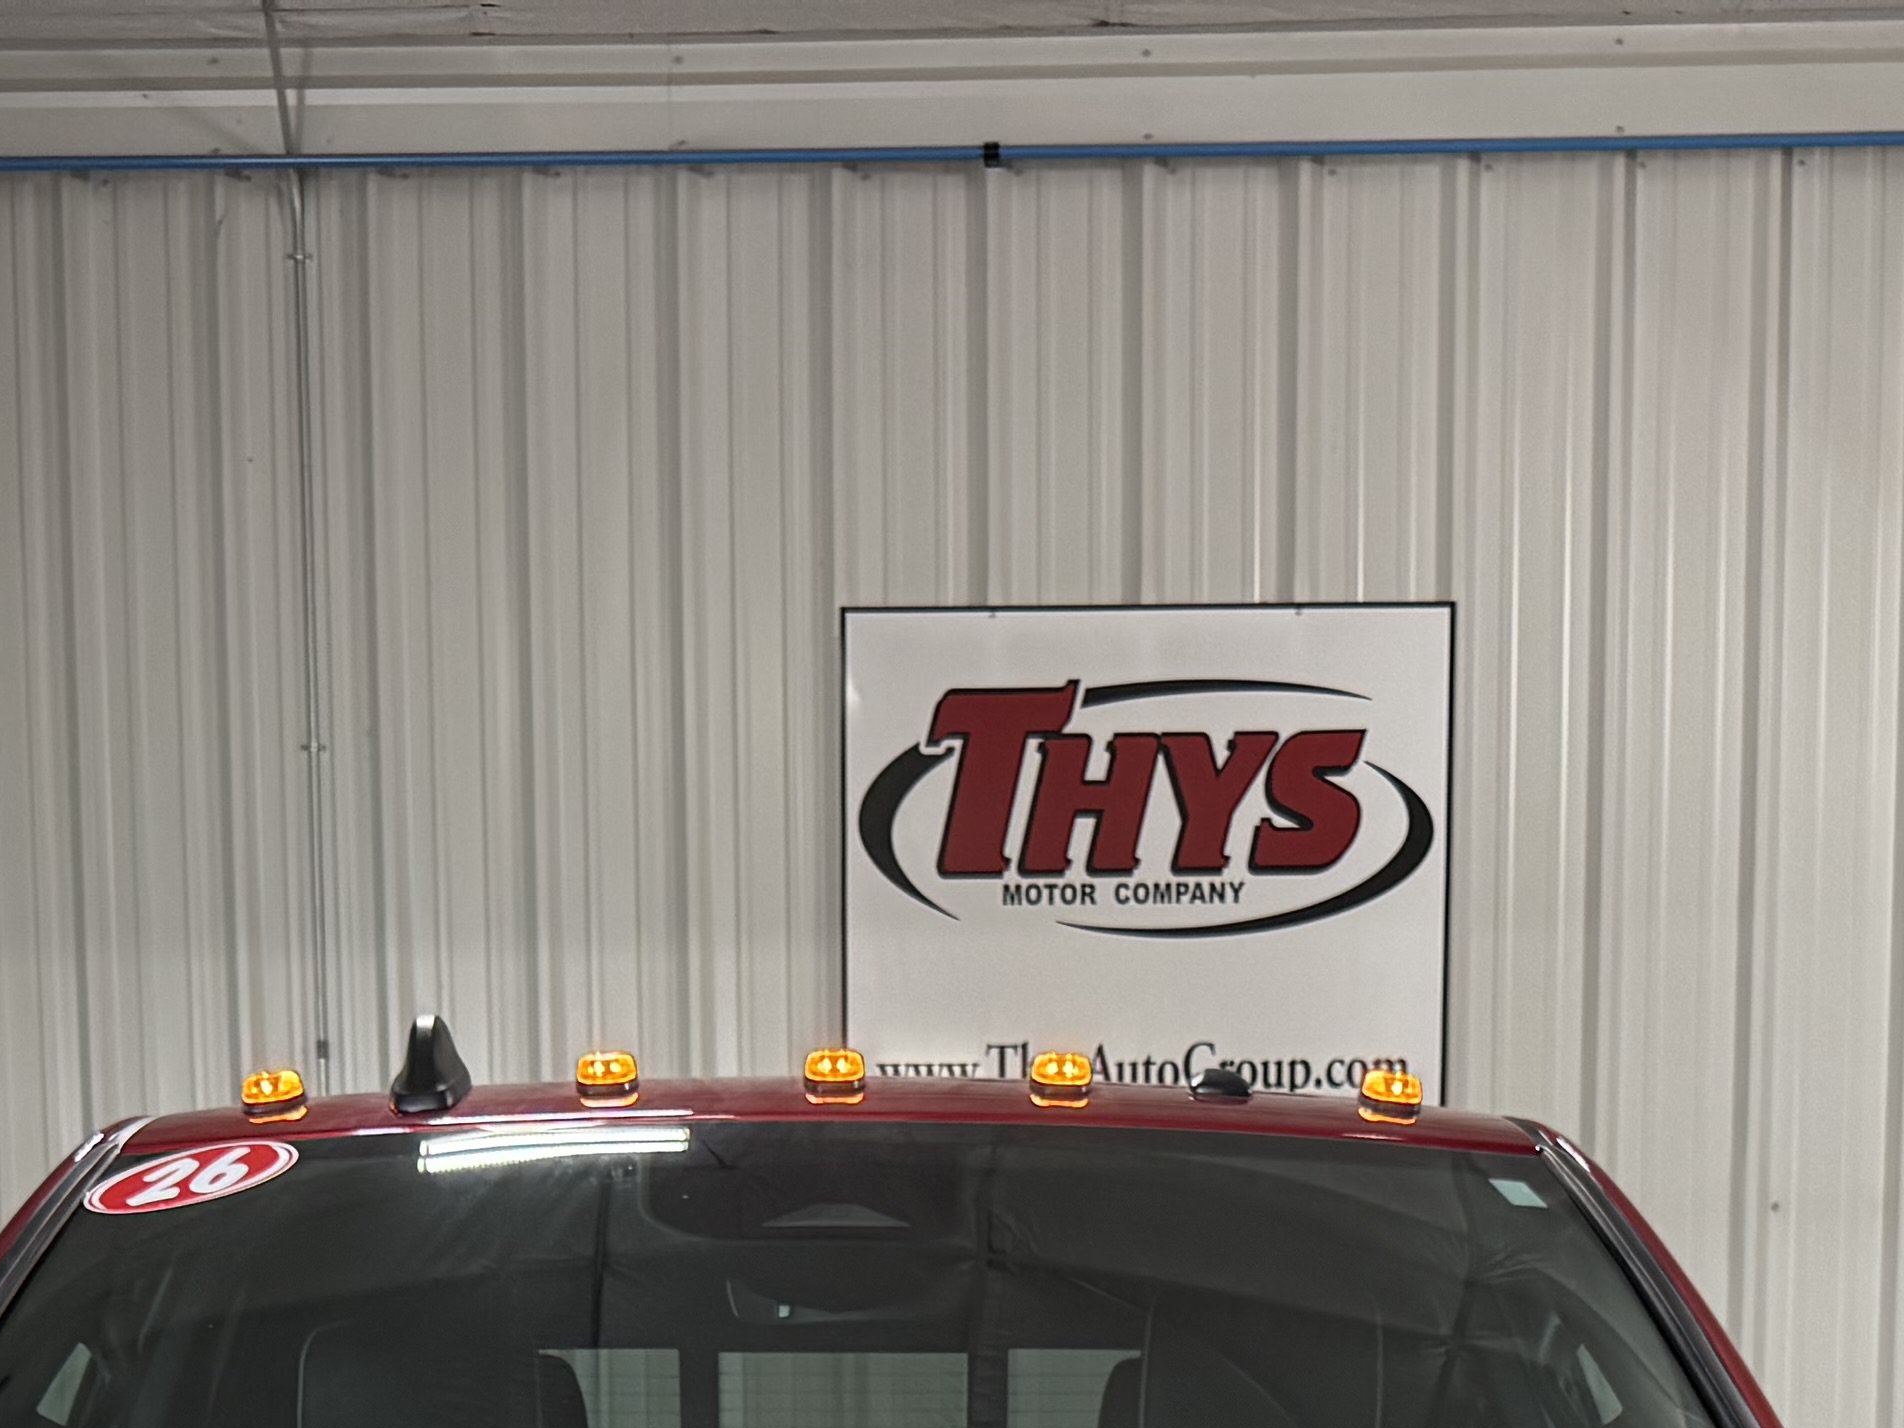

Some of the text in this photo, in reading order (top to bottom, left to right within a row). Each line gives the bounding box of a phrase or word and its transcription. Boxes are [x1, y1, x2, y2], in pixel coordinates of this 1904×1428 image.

[924, 679, 1366, 878] THYS
[1002, 881, 1245, 906] MOTOR COMPANY
[126, 1147, 251, 1207] 26
